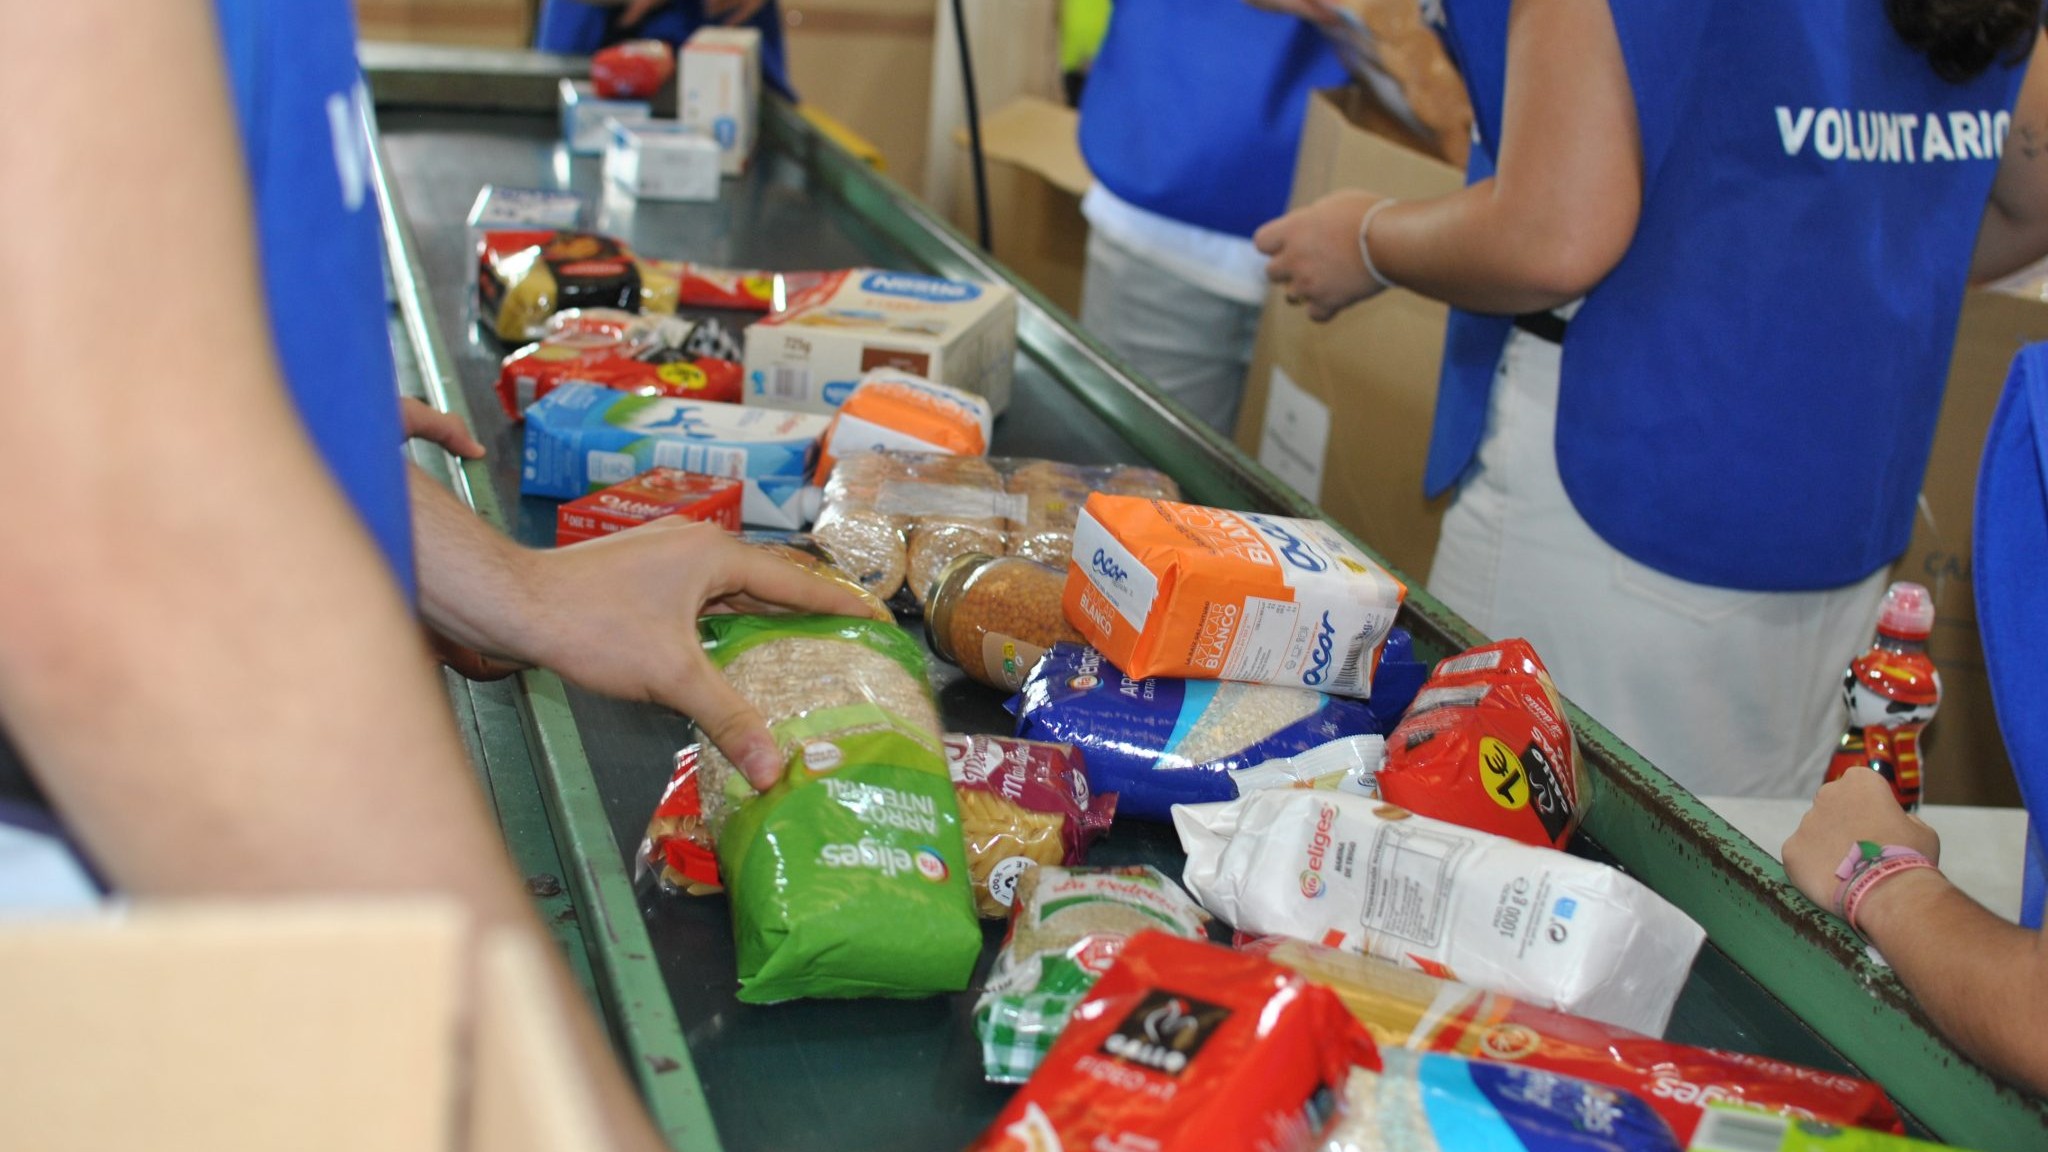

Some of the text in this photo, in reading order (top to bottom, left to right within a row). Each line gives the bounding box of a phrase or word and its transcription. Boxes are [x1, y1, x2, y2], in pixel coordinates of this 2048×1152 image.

[1092, 547, 1128, 581] acor
[1080, 593, 1112, 636] BLANCO
[1206, 604, 1236, 669] BLANCO
[1303, 610, 1335, 685] acor
[1531, 748, 1568, 814] GALLO
[821, 837, 913, 878] eliges
[1307, 806, 1334, 871] eliges
[1499, 906, 1521, 938] 1000
